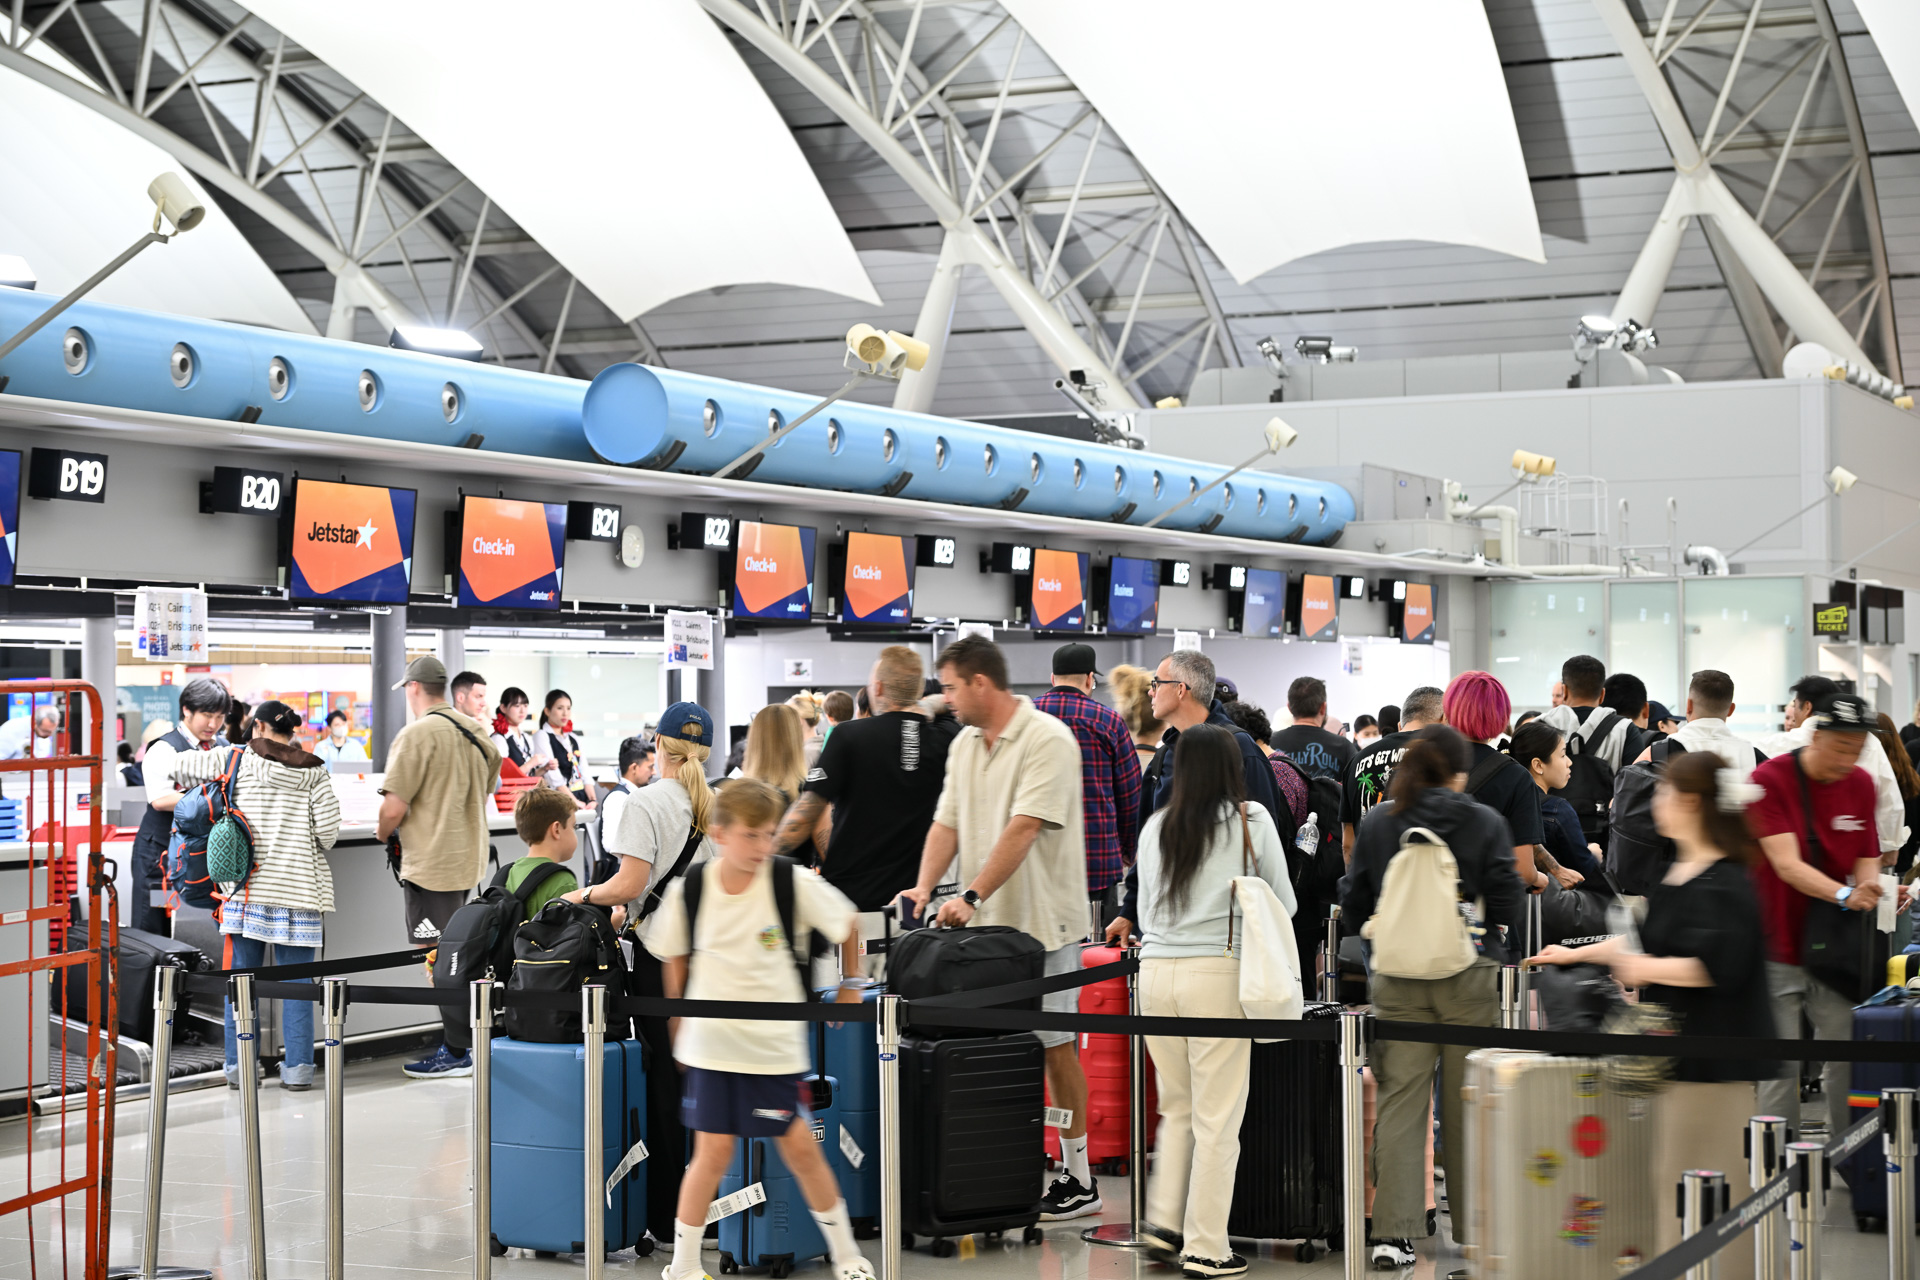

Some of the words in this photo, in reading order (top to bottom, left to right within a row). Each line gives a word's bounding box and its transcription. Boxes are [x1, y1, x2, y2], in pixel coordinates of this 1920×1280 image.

[60, 458, 105, 496] B19
[240, 475, 280, 511] B20
[592, 508, 619, 538] B21
[308, 521, 360, 544] Jetstar
[704, 518, 730, 547] B22
[473, 537, 515, 556] Check-in
[745, 556, 777, 573] Check-in
[853, 564, 882, 581] Check-in
[1038, 578, 1062, 592] Check-in
[1114, 583, 1134, 597] Business
[167, 602, 192, 613] Cairns
[167, 620, 203, 632] Brisbane
[1817, 623, 1848, 631] TICKET
[169, 643, 193, 652] Jetstar
[1306, 742, 1340, 772] ROLL
[1355, 754, 1375, 778] LET'S
[1375, 749, 1392, 767] GET
[413, 929, 441, 939] adidas
[811, 1128, 824, 1140] ETI
